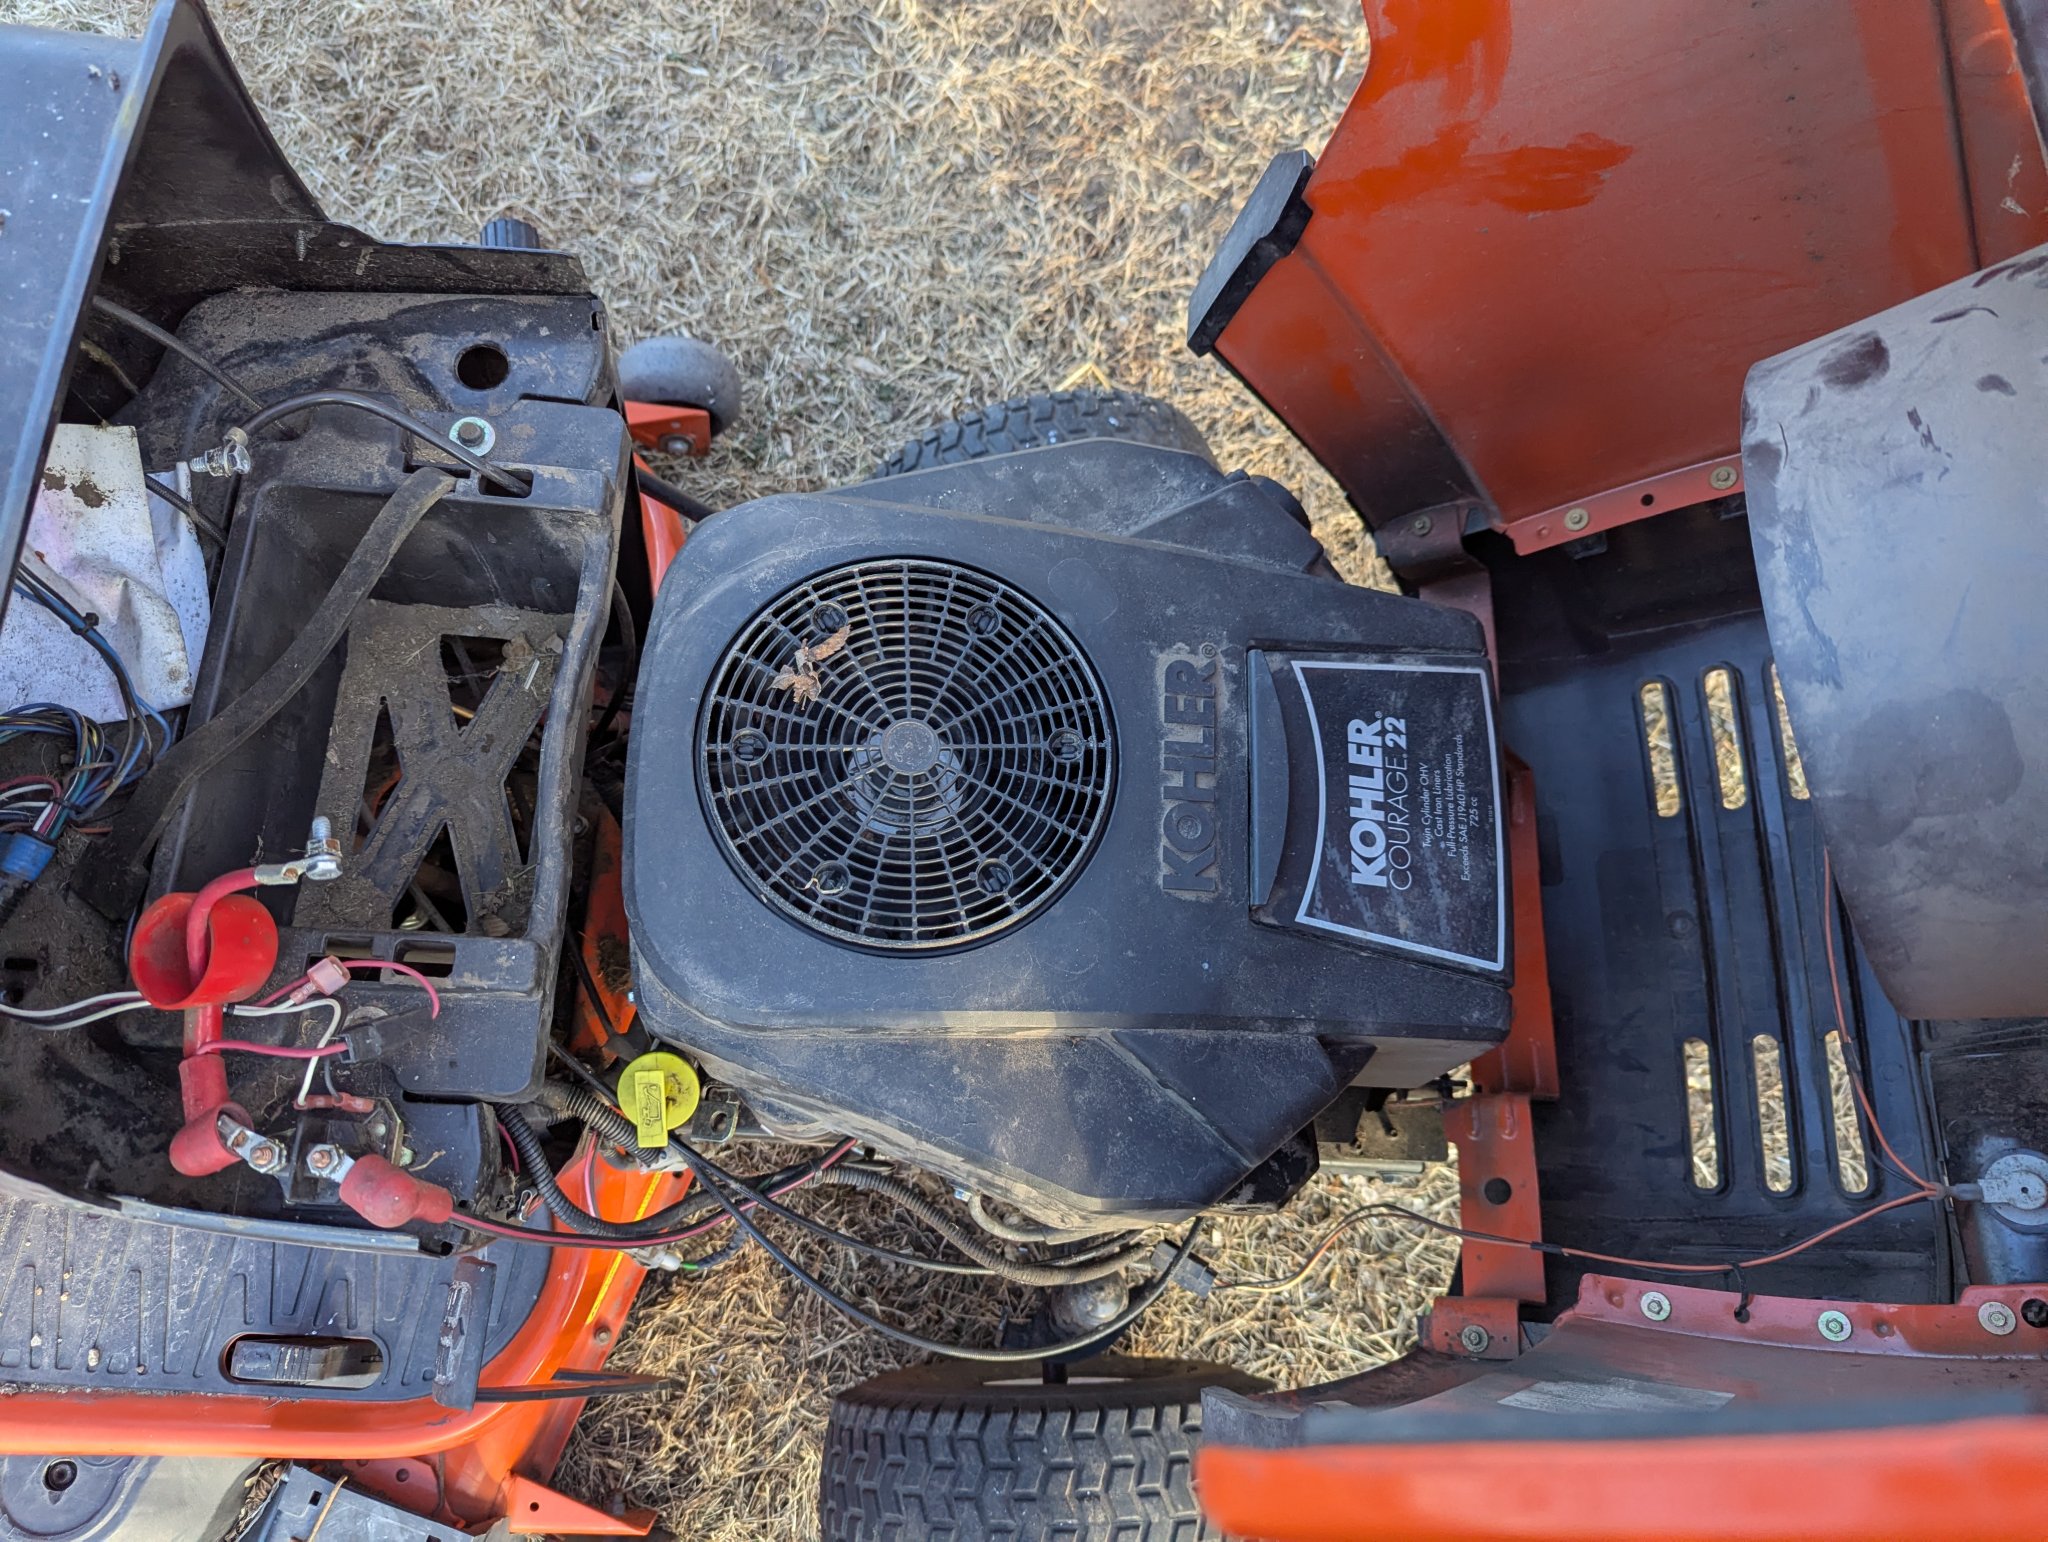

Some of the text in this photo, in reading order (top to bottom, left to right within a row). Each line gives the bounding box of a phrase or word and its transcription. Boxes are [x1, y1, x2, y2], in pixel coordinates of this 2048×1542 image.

[1384, 716, 1407, 750] 22
[1419, 762, 1433, 848] Twin Cylinder OHV
[1432, 770, 1444, 837] Cast Iron Liners
[1443, 753, 1456, 857] Full-Pressure Lubrication
[1452, 734, 1470, 881] Exceeds SAE J1940 HP Standards
[1468, 796, 1479, 827] 725 cc
